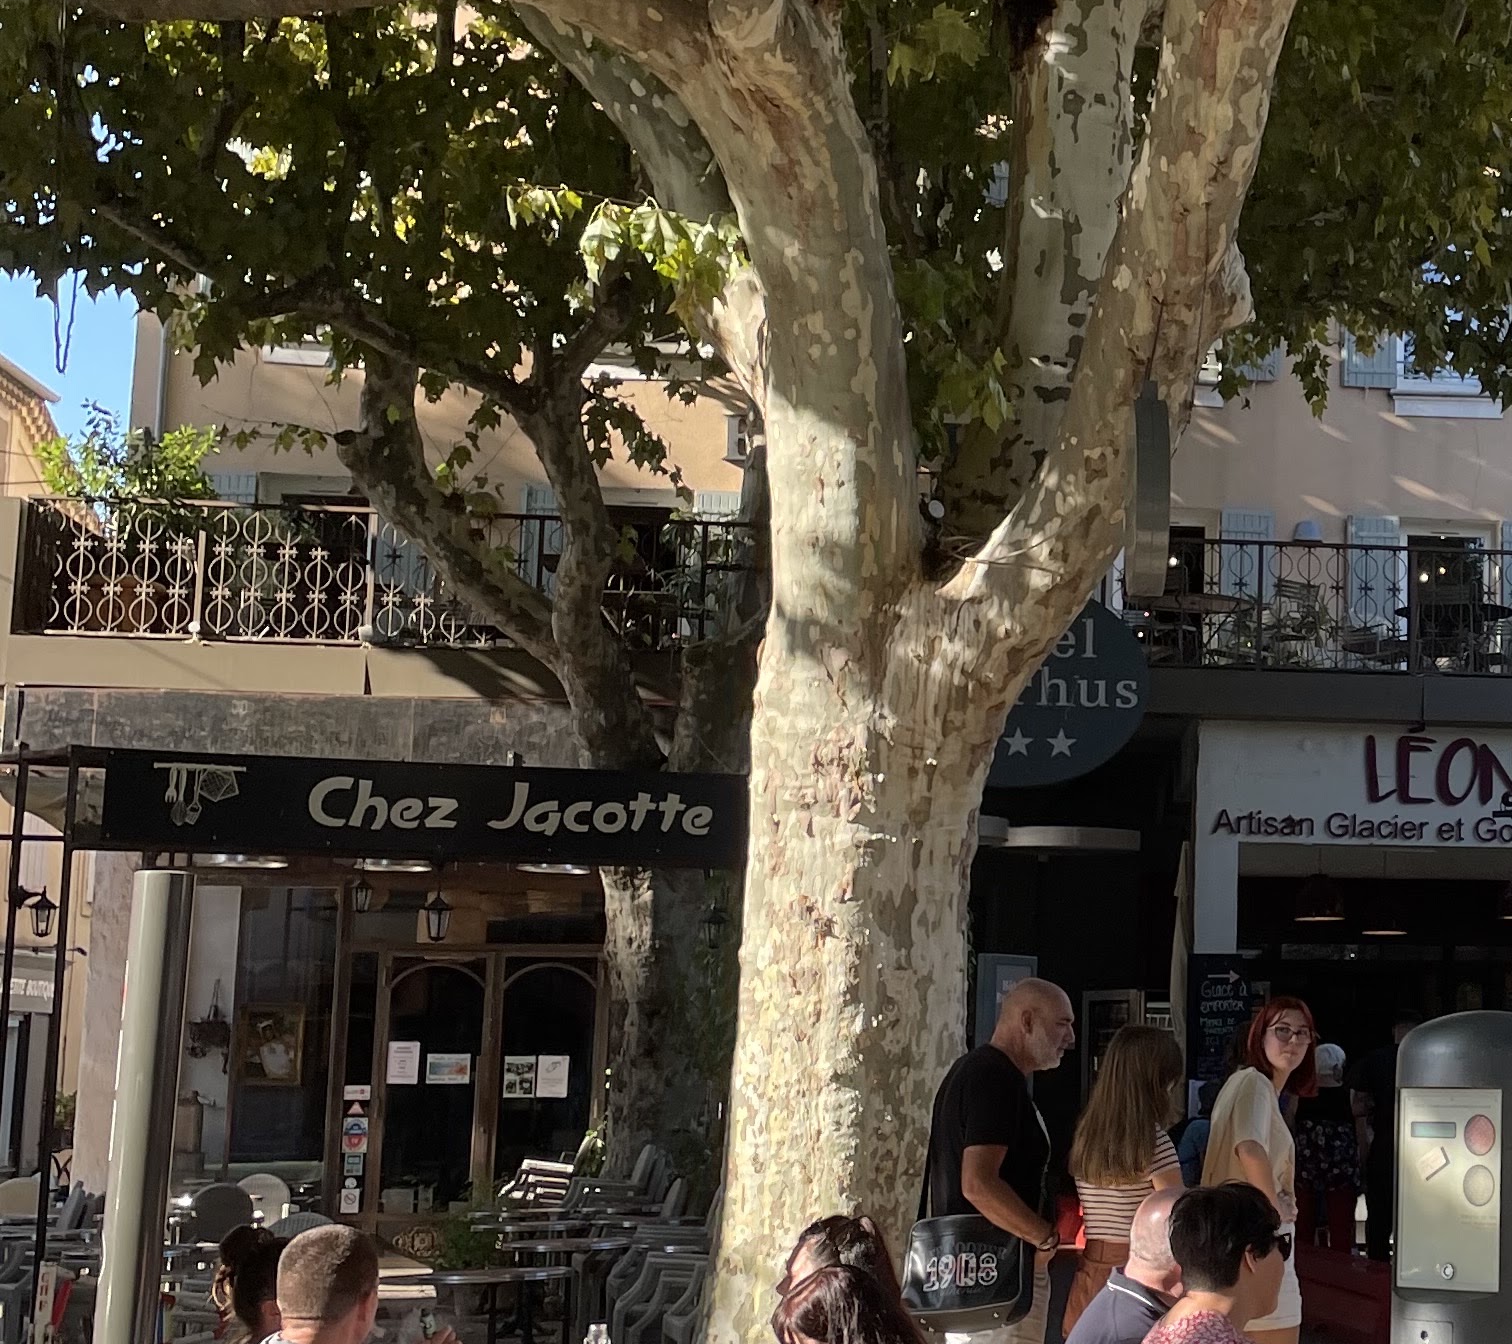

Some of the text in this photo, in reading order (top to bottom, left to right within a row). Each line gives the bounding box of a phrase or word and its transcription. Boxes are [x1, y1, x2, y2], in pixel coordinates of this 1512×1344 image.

[308, 775, 714, 836] Chez Jacotte
[1211, 809, 1314, 837] Artisan
[1327, 813, 1429, 840] Glacier
[1439, 817, 1465, 842] et
[922, 1252, 998, 1292] 1908
